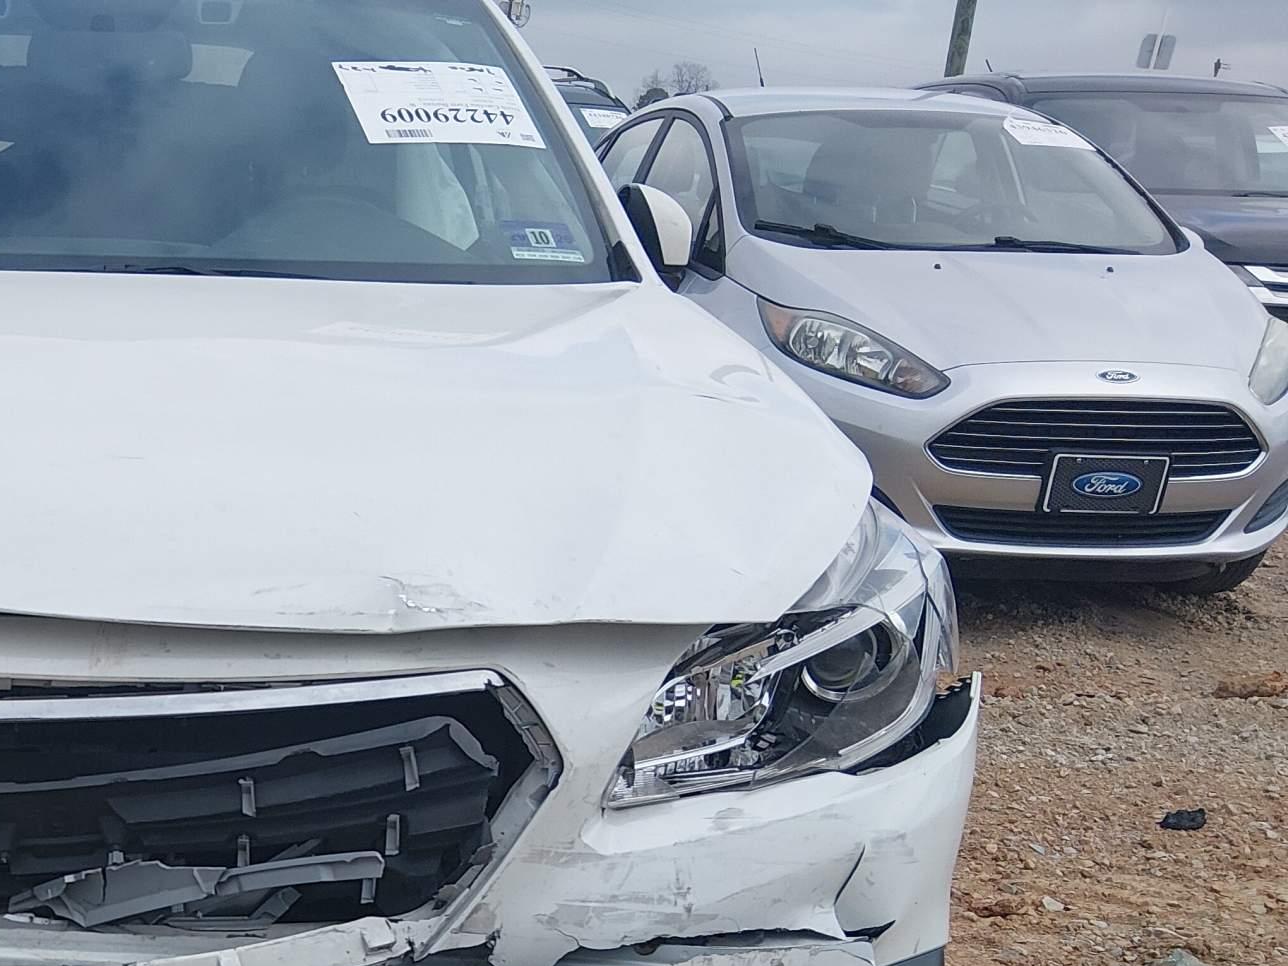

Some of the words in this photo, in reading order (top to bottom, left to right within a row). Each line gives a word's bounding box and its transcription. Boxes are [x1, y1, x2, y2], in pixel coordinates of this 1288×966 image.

[381, 107, 514, 126] 44229009
[529, 230, 551, 245] 10
[1105, 370, 1130, 380] Ford
[1084, 475, 1127, 494] Ford
